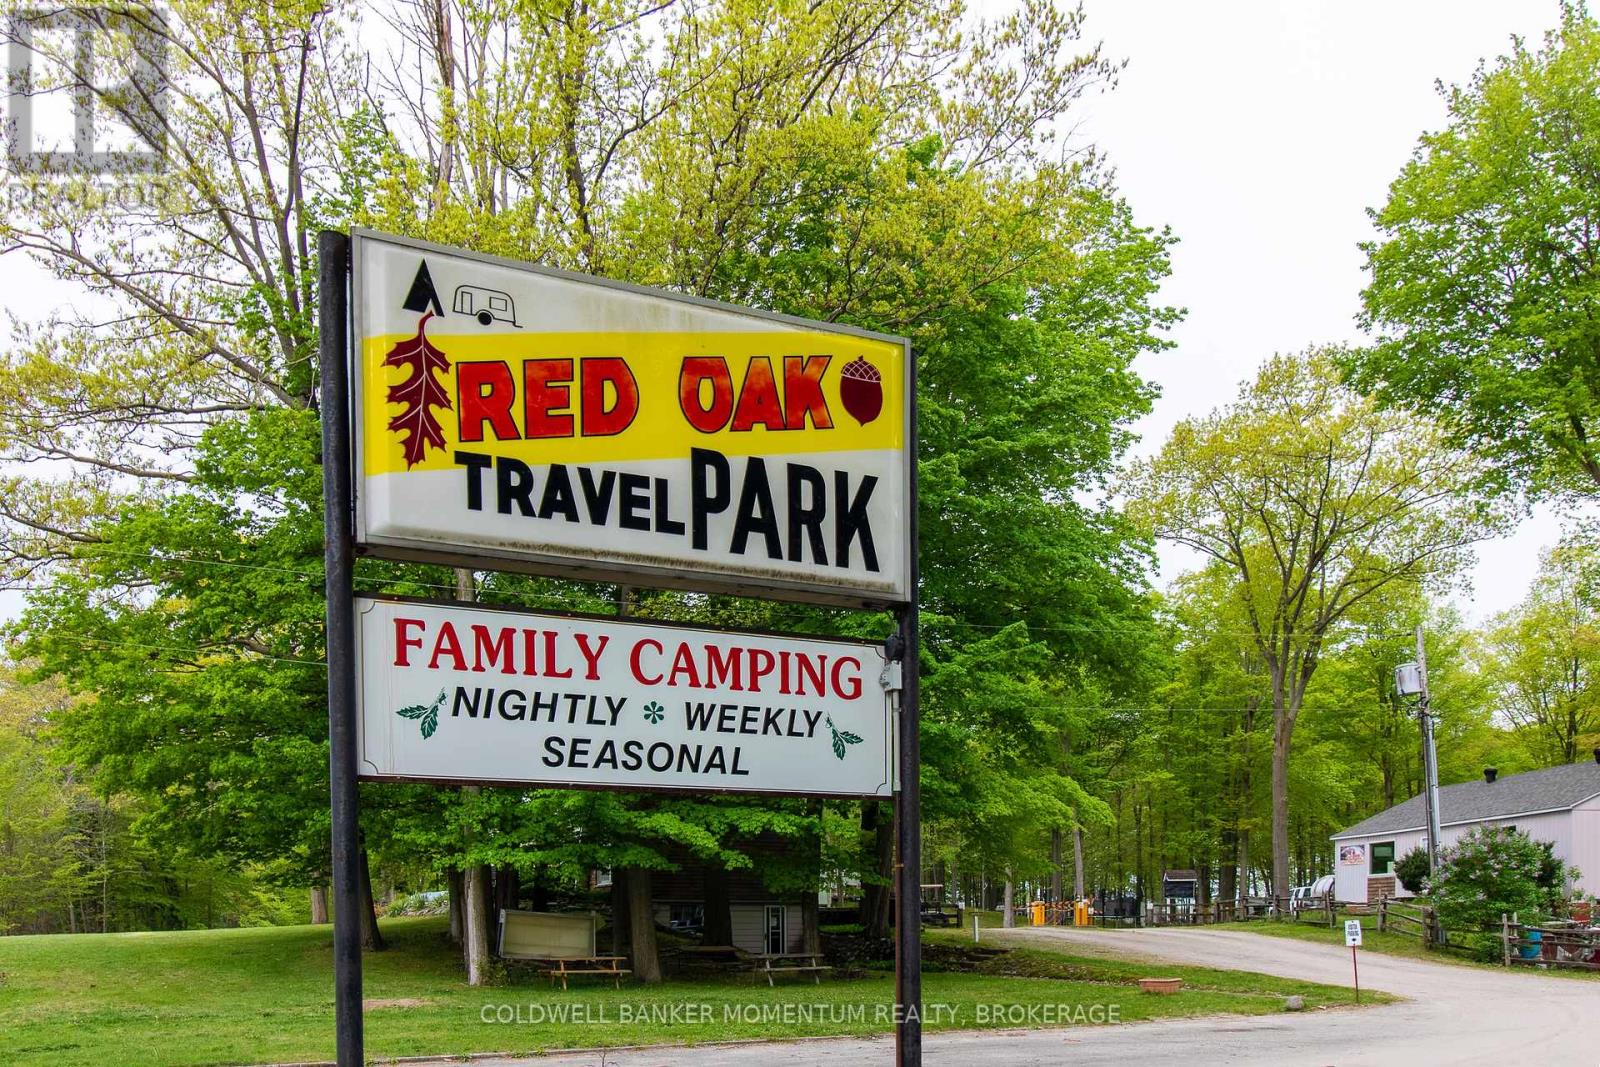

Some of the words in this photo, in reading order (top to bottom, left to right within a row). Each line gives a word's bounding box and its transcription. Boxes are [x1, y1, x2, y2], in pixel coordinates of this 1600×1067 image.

[455, 356, 640, 442] RED
[678, 354, 835, 434] OAK
[454, 450, 686, 536] TRAVEL
[690, 447, 880, 573] PARK
[393, 618, 610, 681] FAMILY
[629, 638, 863, 701] CAMPING
[452, 686, 628, 727] NIGHTLY
[684, 702, 824, 738] WEEKLY
[541, 736, 750, 776] SEASONAL
